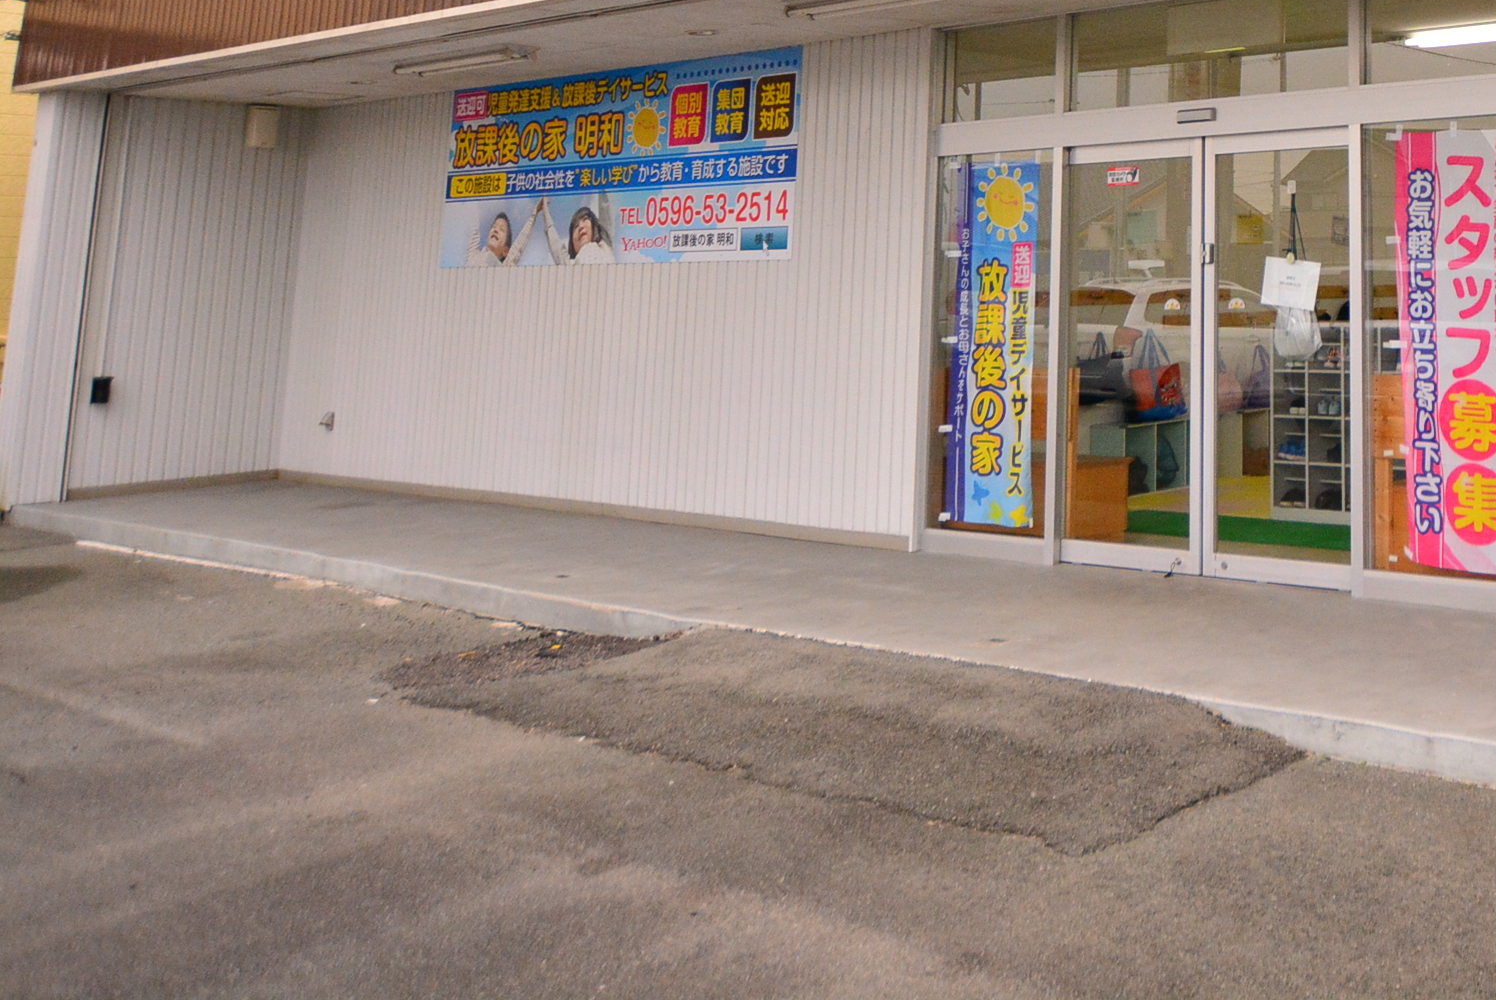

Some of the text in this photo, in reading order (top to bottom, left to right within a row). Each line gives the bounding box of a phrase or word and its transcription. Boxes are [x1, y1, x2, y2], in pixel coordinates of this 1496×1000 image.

[456, 94, 487, 117] 送迎可
[675, 91, 703, 115] 個別
[716, 87, 745, 111] 集団
[760, 81, 791, 107] 送迎
[674, 116, 702, 139] 教育
[715, 111, 744, 136] 教育
[758, 106, 790, 132] 対応
[452, 111, 625, 169] 放課後の家 明和
[455, 177, 502, 195] この施設は
[620, 190, 788, 227] TEL 0596-53-2514
[672, 232, 735, 248] 放課後の家 明和
[1014, 244, 1031, 285] 送迎
[970, 257, 1009, 476] 放課後の家
